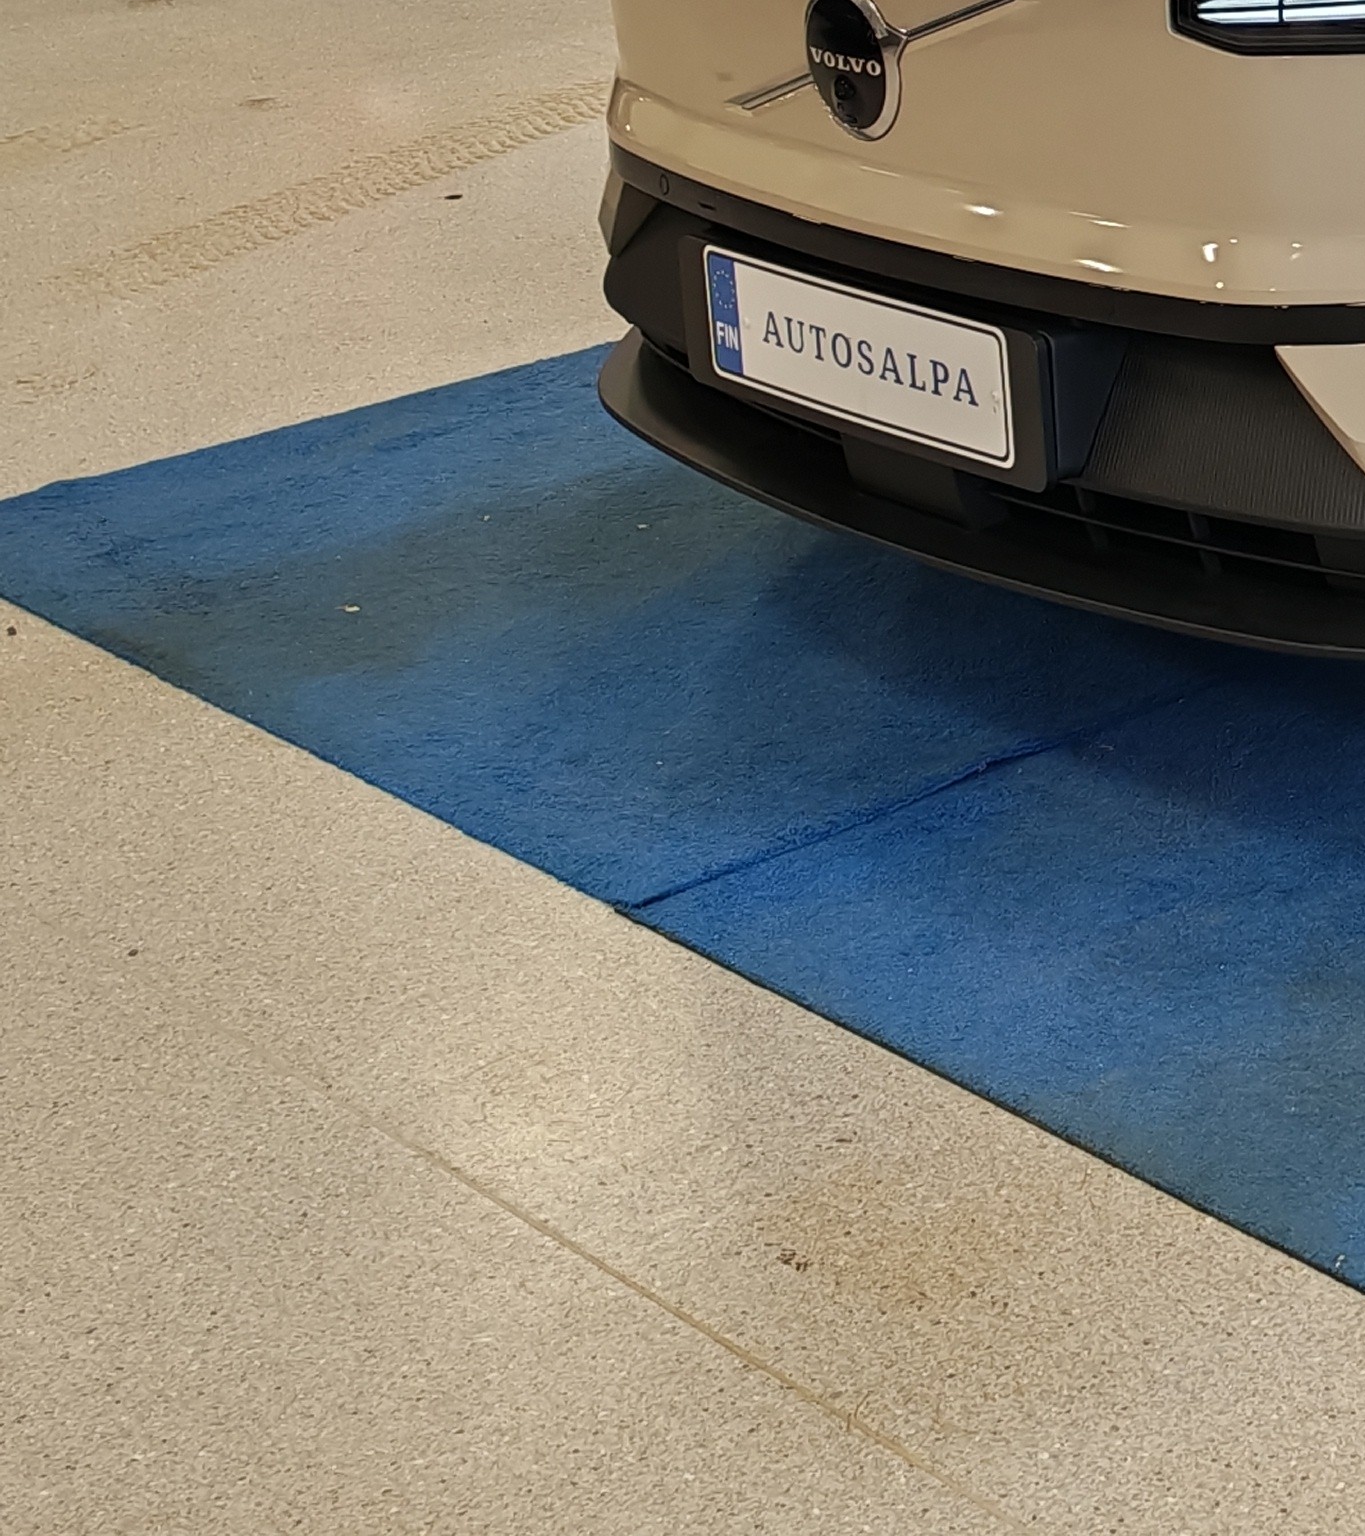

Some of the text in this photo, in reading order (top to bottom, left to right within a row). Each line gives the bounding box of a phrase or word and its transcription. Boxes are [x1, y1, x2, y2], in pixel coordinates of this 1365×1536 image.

[810, 46, 881, 77] VOLVO
[715, 321, 740, 351] FIN
[762, 311, 979, 407] AUTOSALPA
